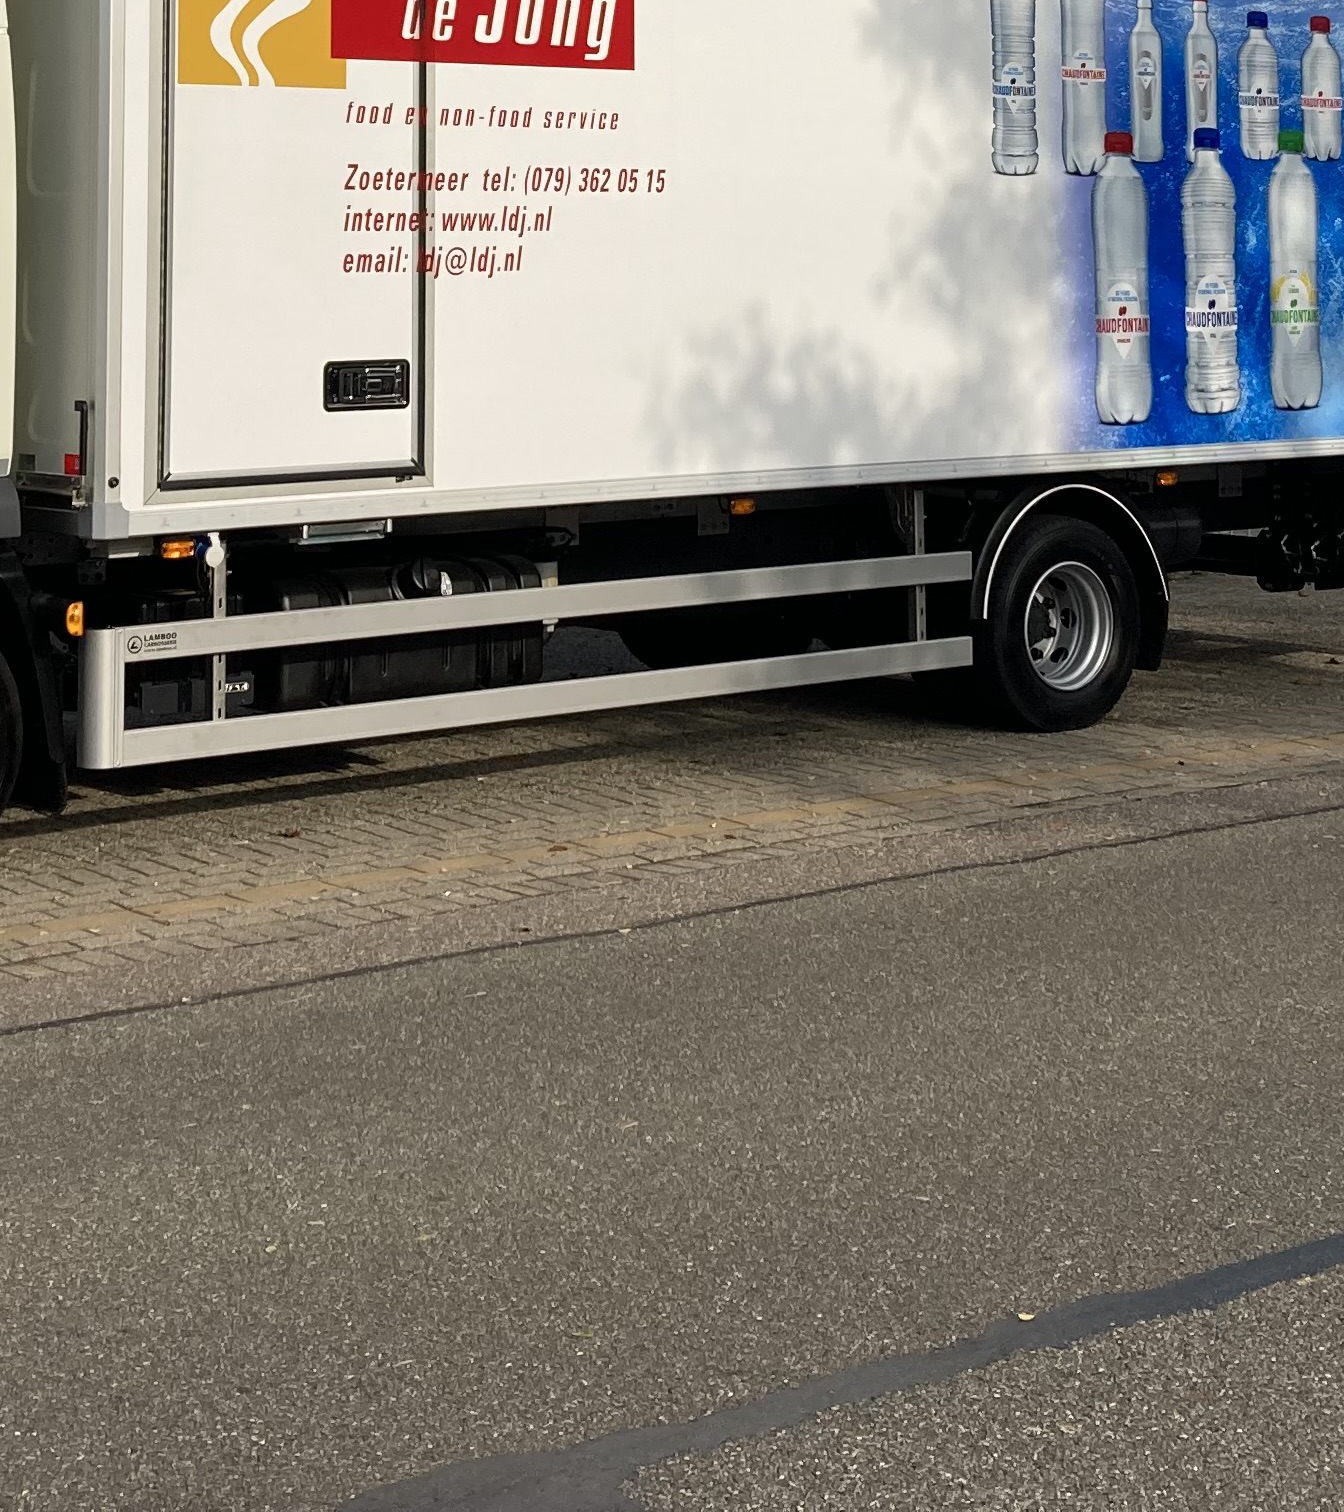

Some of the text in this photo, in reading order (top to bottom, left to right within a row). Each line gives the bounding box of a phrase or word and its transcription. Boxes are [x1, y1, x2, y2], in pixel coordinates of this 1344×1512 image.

[346, 101, 393, 124] food
[440, 105, 532, 128] non-food
[543, 109, 619, 130] service
[344, 164, 666, 196] Zoetermeer tel: (079) 362 05 15
[344, 205, 553, 238] internet: www.ldj.nl
[343, 245, 523, 279] email: ldj@ldj.nl
